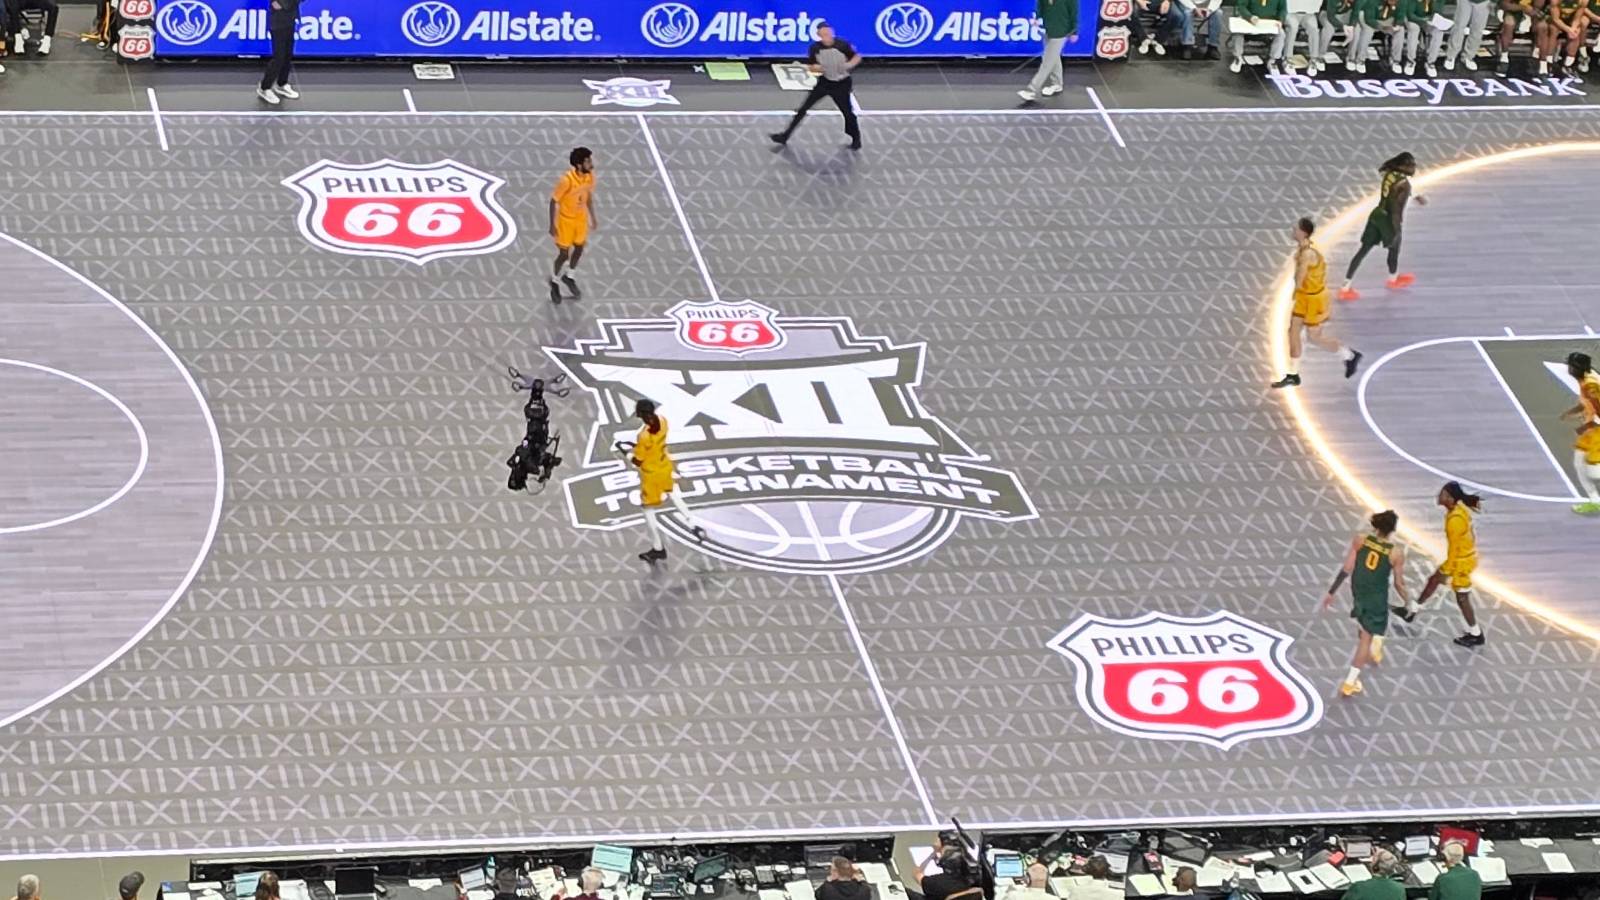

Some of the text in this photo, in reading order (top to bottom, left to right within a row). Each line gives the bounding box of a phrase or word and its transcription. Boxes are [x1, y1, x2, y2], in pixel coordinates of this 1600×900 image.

[126, 0, 150, 13] 66
[1106, 2, 1127, 15] 66
[218, 9, 353, 40] Allate
[461, 11, 594, 41] Allstate
[933, 11, 1045, 41] Allstat
[125, 39, 148, 52] 66
[1102, 40, 1124, 53] 66
[322, 177, 468, 193] PHILLIPS
[344, 202, 465, 238] 66
[686, 309, 760, 319] PHILLIPS
[698, 323, 760, 343] 66
[582, 357, 941, 446] XII
[601, 454, 982, 492] BSKETBALL
[1365, 550, 1380, 570] 0
[1091, 633, 1255, 657] PHILLIPS
[1127, 666, 1260, 715] 66
